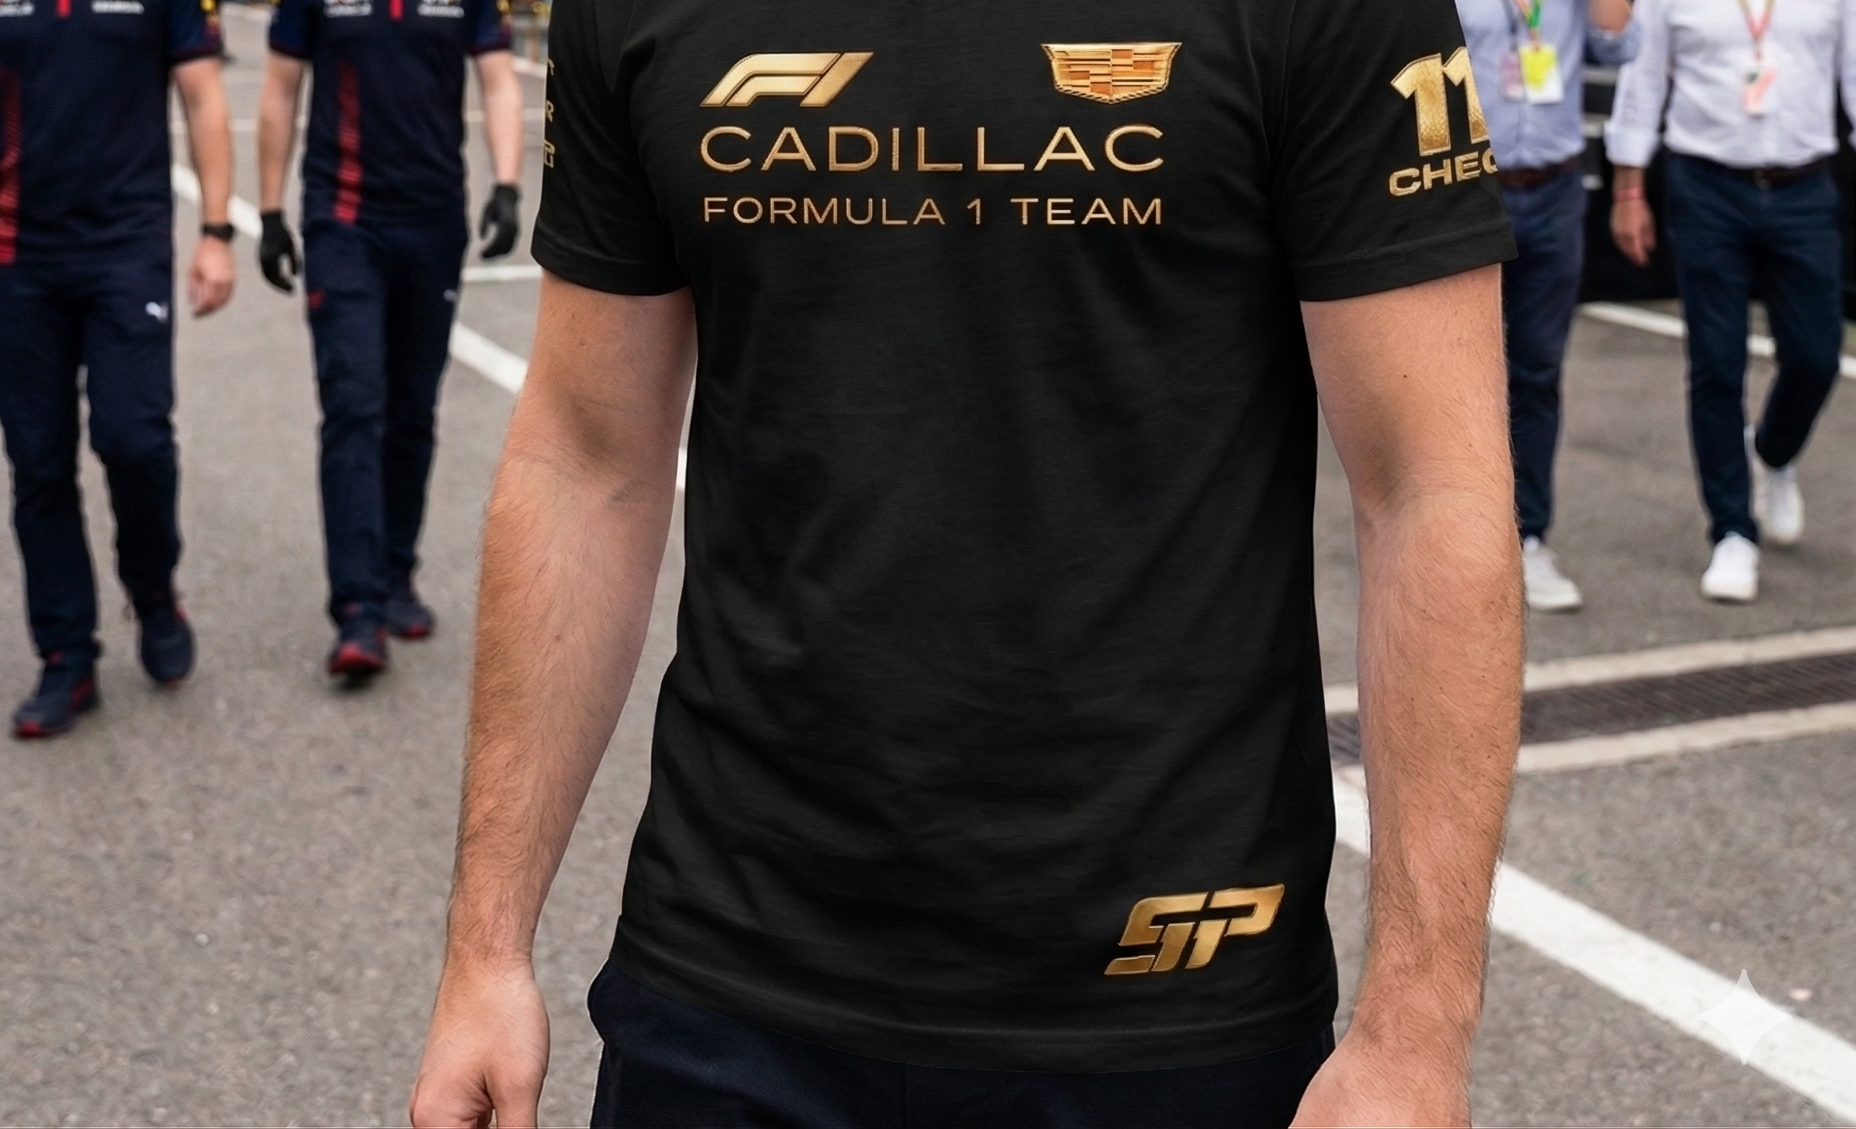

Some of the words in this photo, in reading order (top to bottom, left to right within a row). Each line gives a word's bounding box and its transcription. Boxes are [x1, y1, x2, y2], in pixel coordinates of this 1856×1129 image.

[700, 51, 875, 107] F1
[1391, 45, 1489, 156] 11
[700, 125, 1164, 172] CADILLAC
[704, 197, 946, 226] FORMULA
[967, 198, 981, 225] 1
[1010, 197, 1162, 226] TEAM
